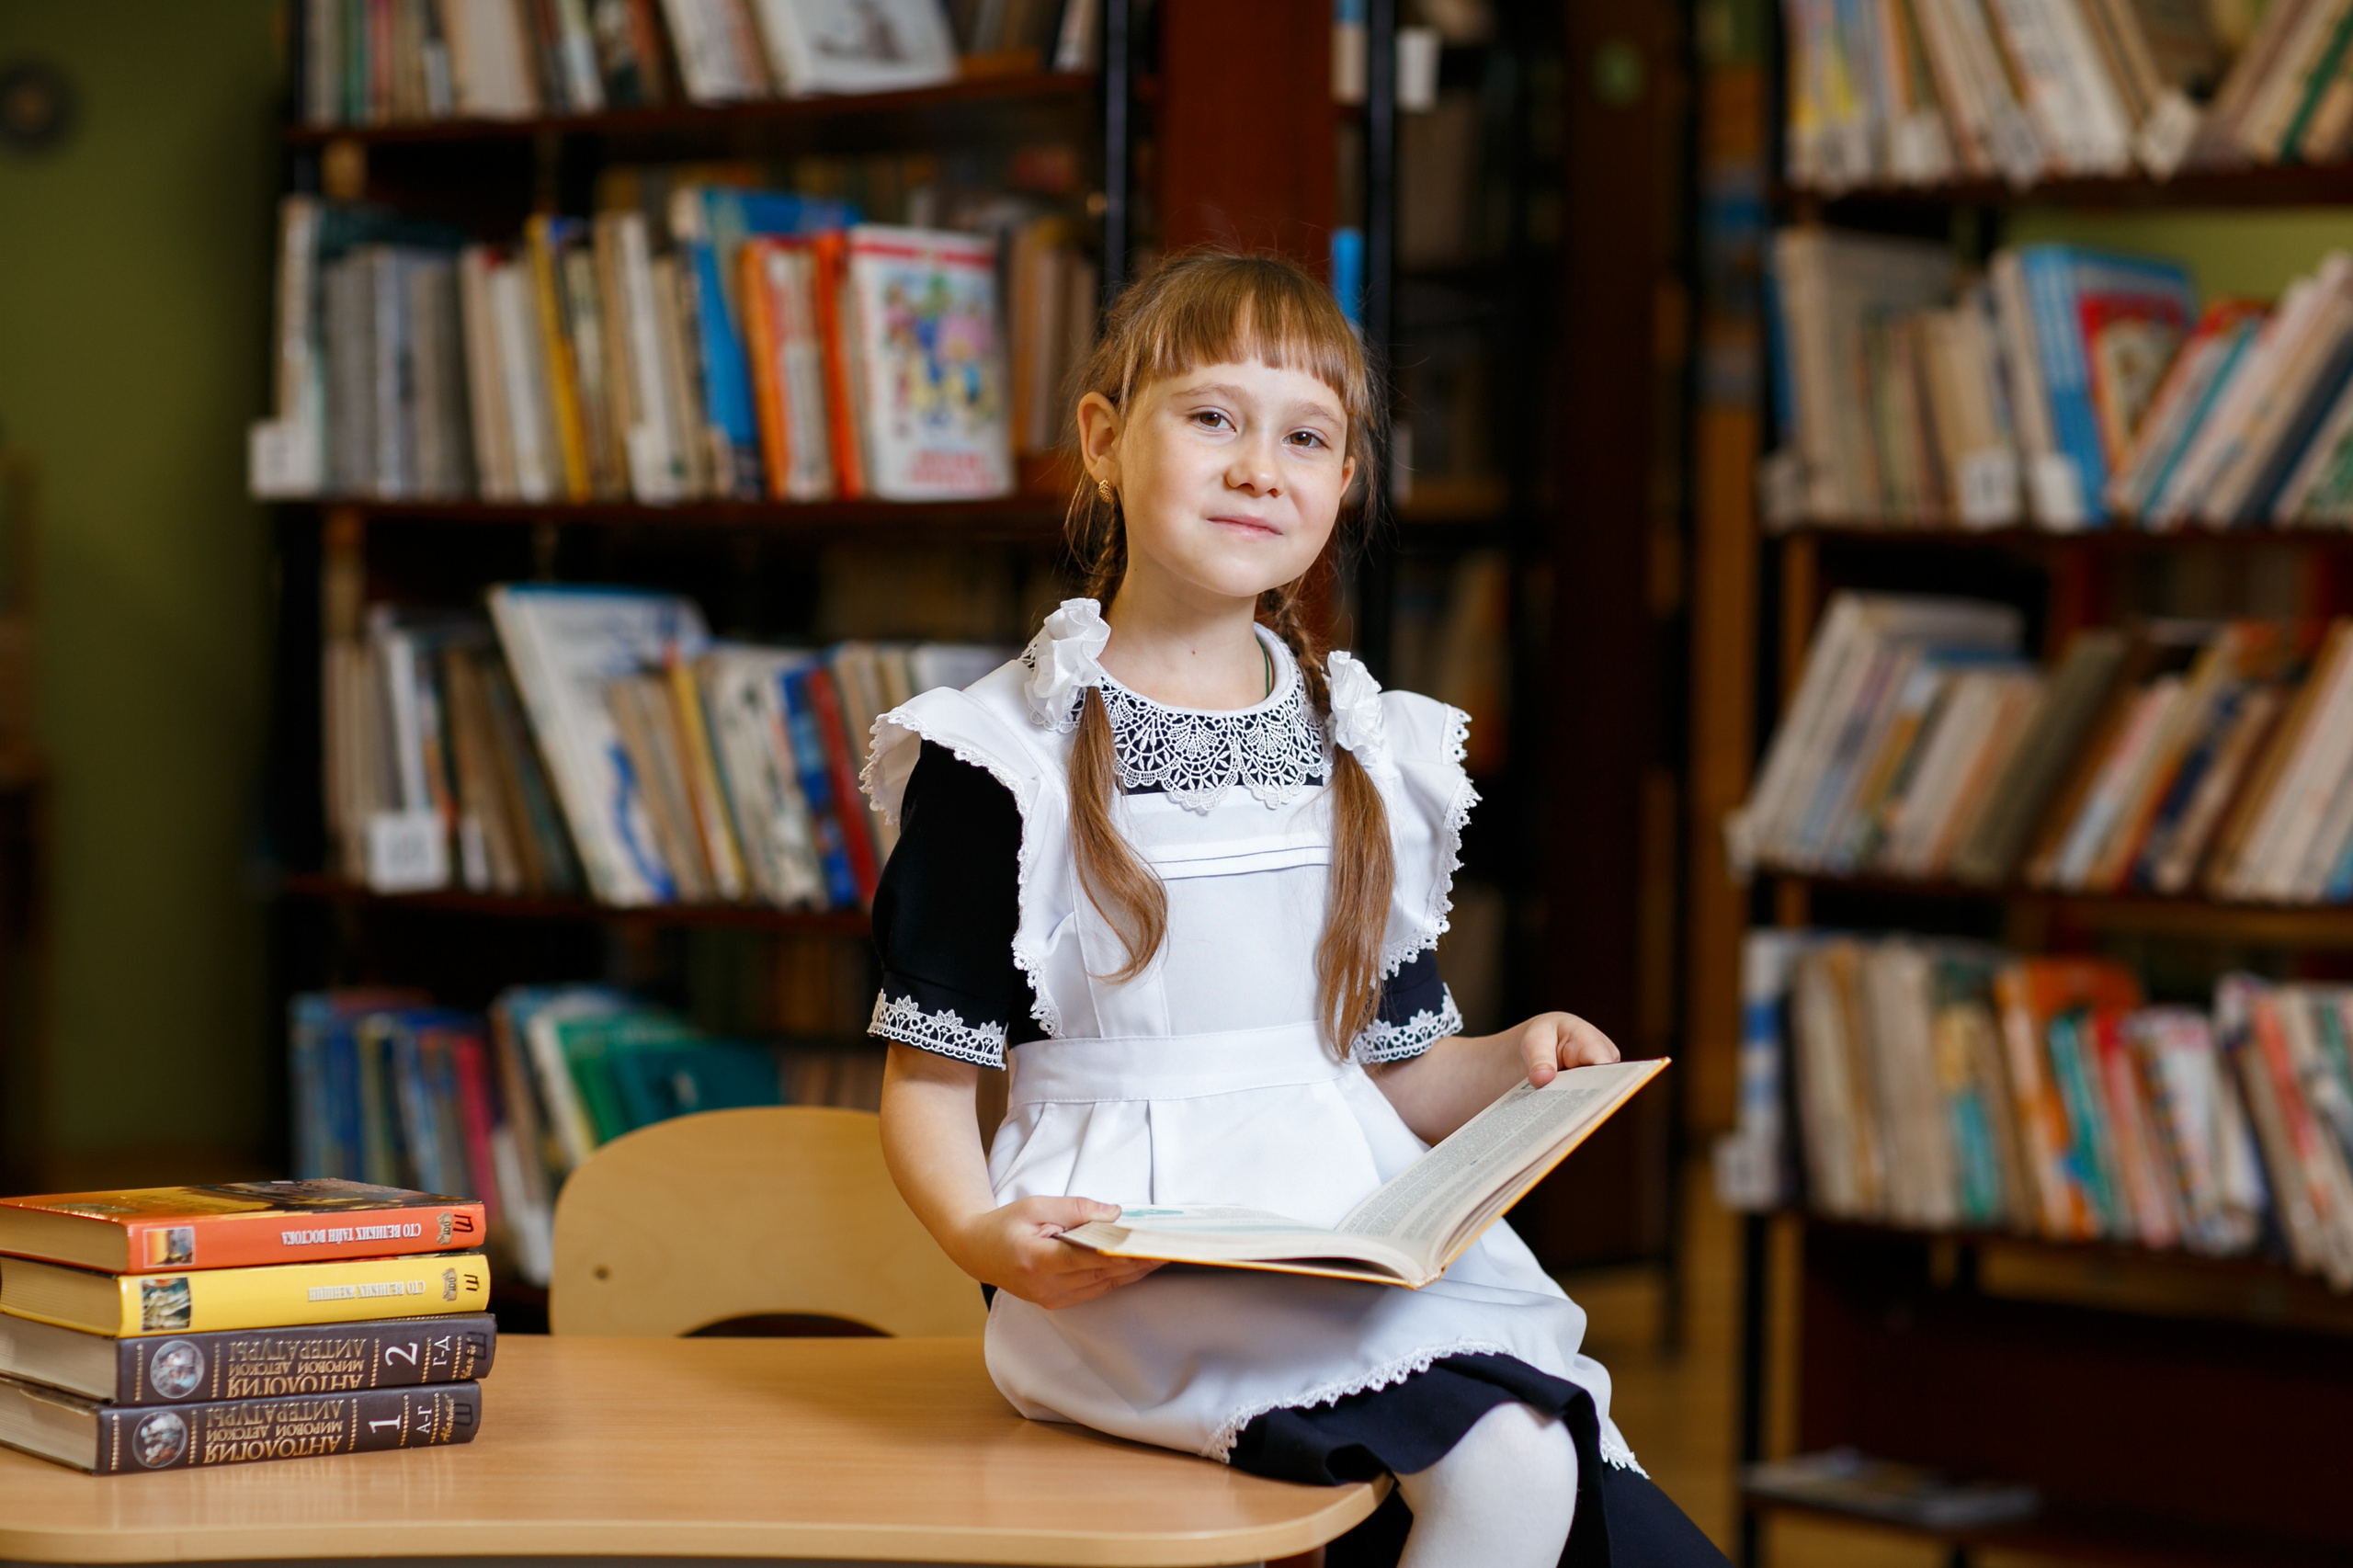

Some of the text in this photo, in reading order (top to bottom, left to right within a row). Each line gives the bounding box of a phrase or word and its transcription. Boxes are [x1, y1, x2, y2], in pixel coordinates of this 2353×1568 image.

[280, 1222, 422, 1245] СТО ВЕЛИКИХ ТАЙН ВОСТОКА
[308, 1279, 426, 1301] СТО ВЕЛИКИХ ЖЕНЩИН
[228, 1337, 367, 1362] ЛИТЕРАТУРЫ
[384, 1342, 418, 1367] 2
[432, 1335, 451, 1367] Г-Д
[228, 1359, 365, 1381] МИРОВОЙ ДЕТСКОЙ
[225, 1374, 364, 1398] АНТОЛОГИЯ
[205, 1399, 345, 1427] ЛИТЕРАТУРЫ
[369, 1415, 402, 1434] 1
[415, 1405, 433, 1434] А-Г
[205, 1420, 344, 1445] МИРОВОЙ ДЕТСКОЙ
[203, 1435, 344, 1463] АНТОЛОГИЯ
